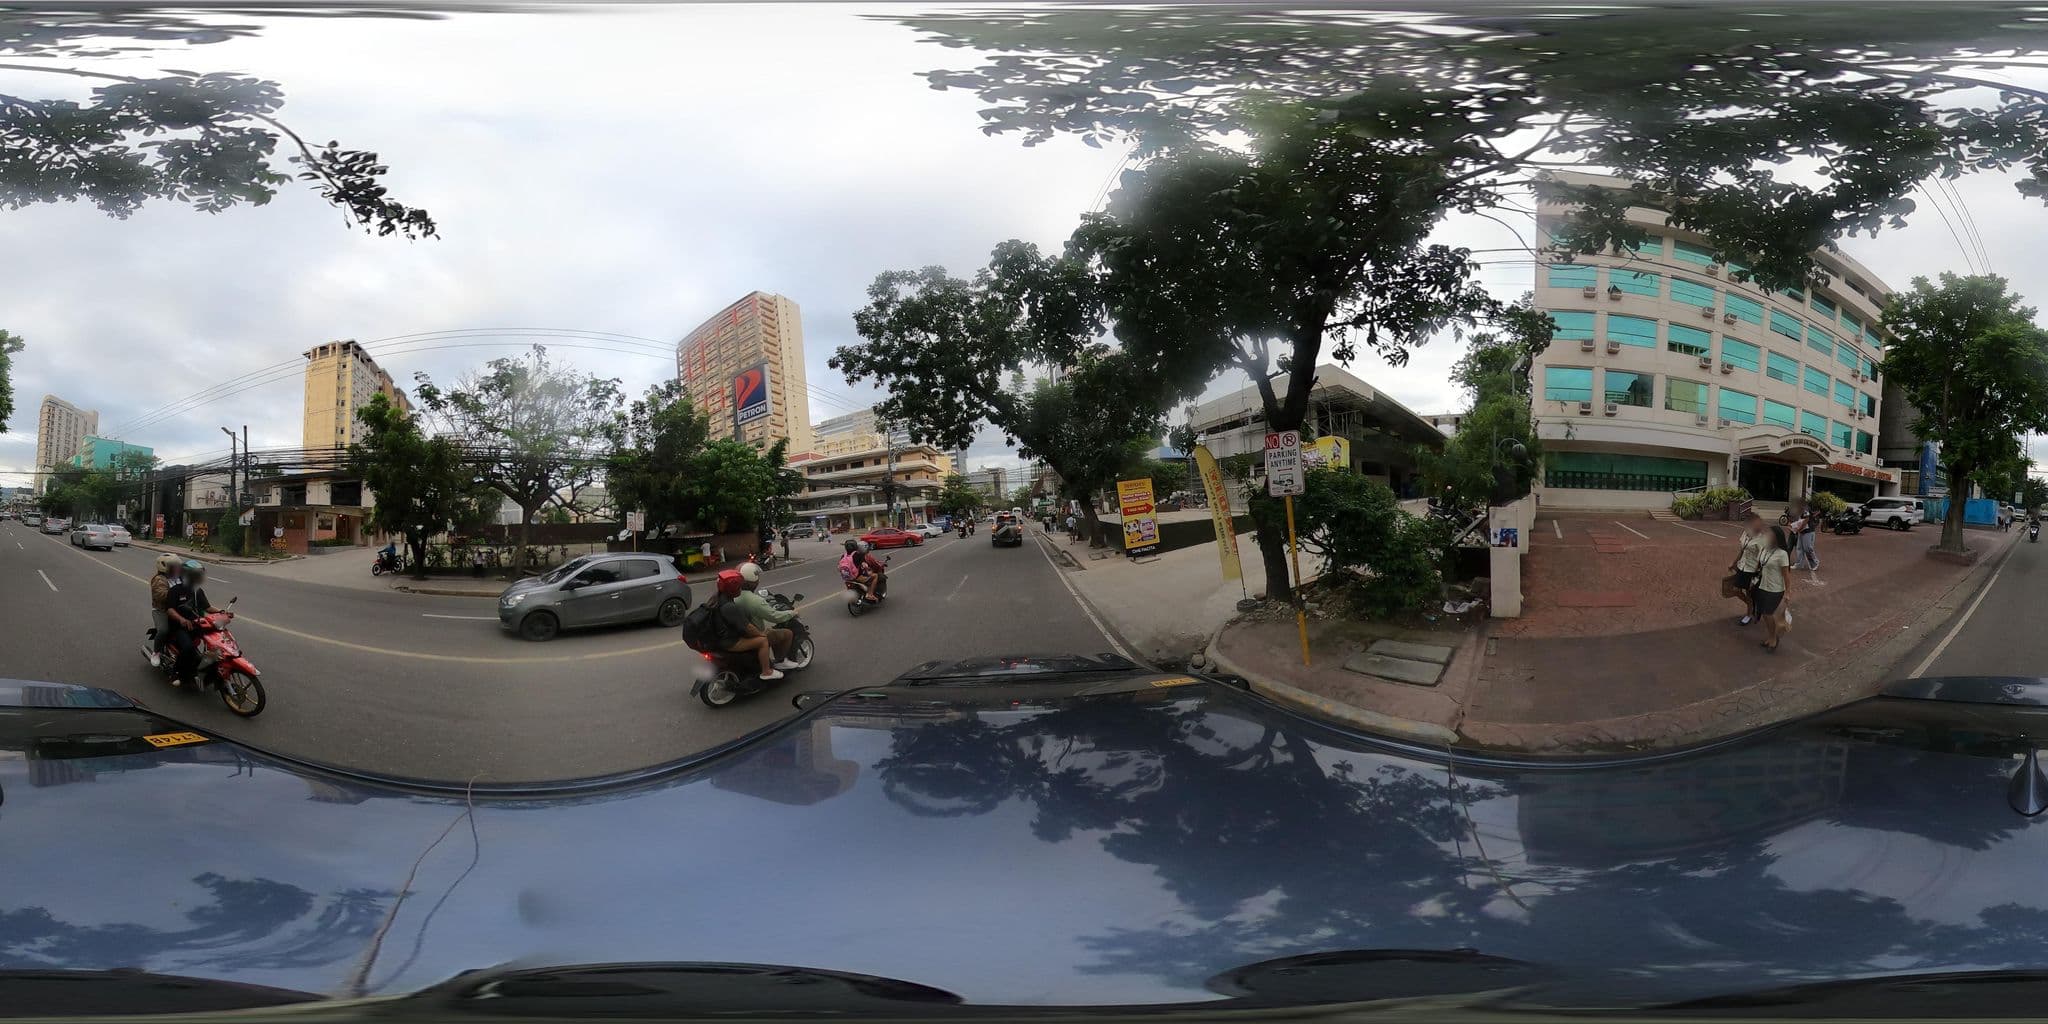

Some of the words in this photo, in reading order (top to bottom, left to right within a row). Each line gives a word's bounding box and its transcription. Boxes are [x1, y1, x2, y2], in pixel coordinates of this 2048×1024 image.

[739, 404, 766, 421] PETRON
[1266, 435, 1279, 448] NO
[1269, 449, 1297, 459] PARKING
[1270, 458, 1296, 468] ANYTIME
